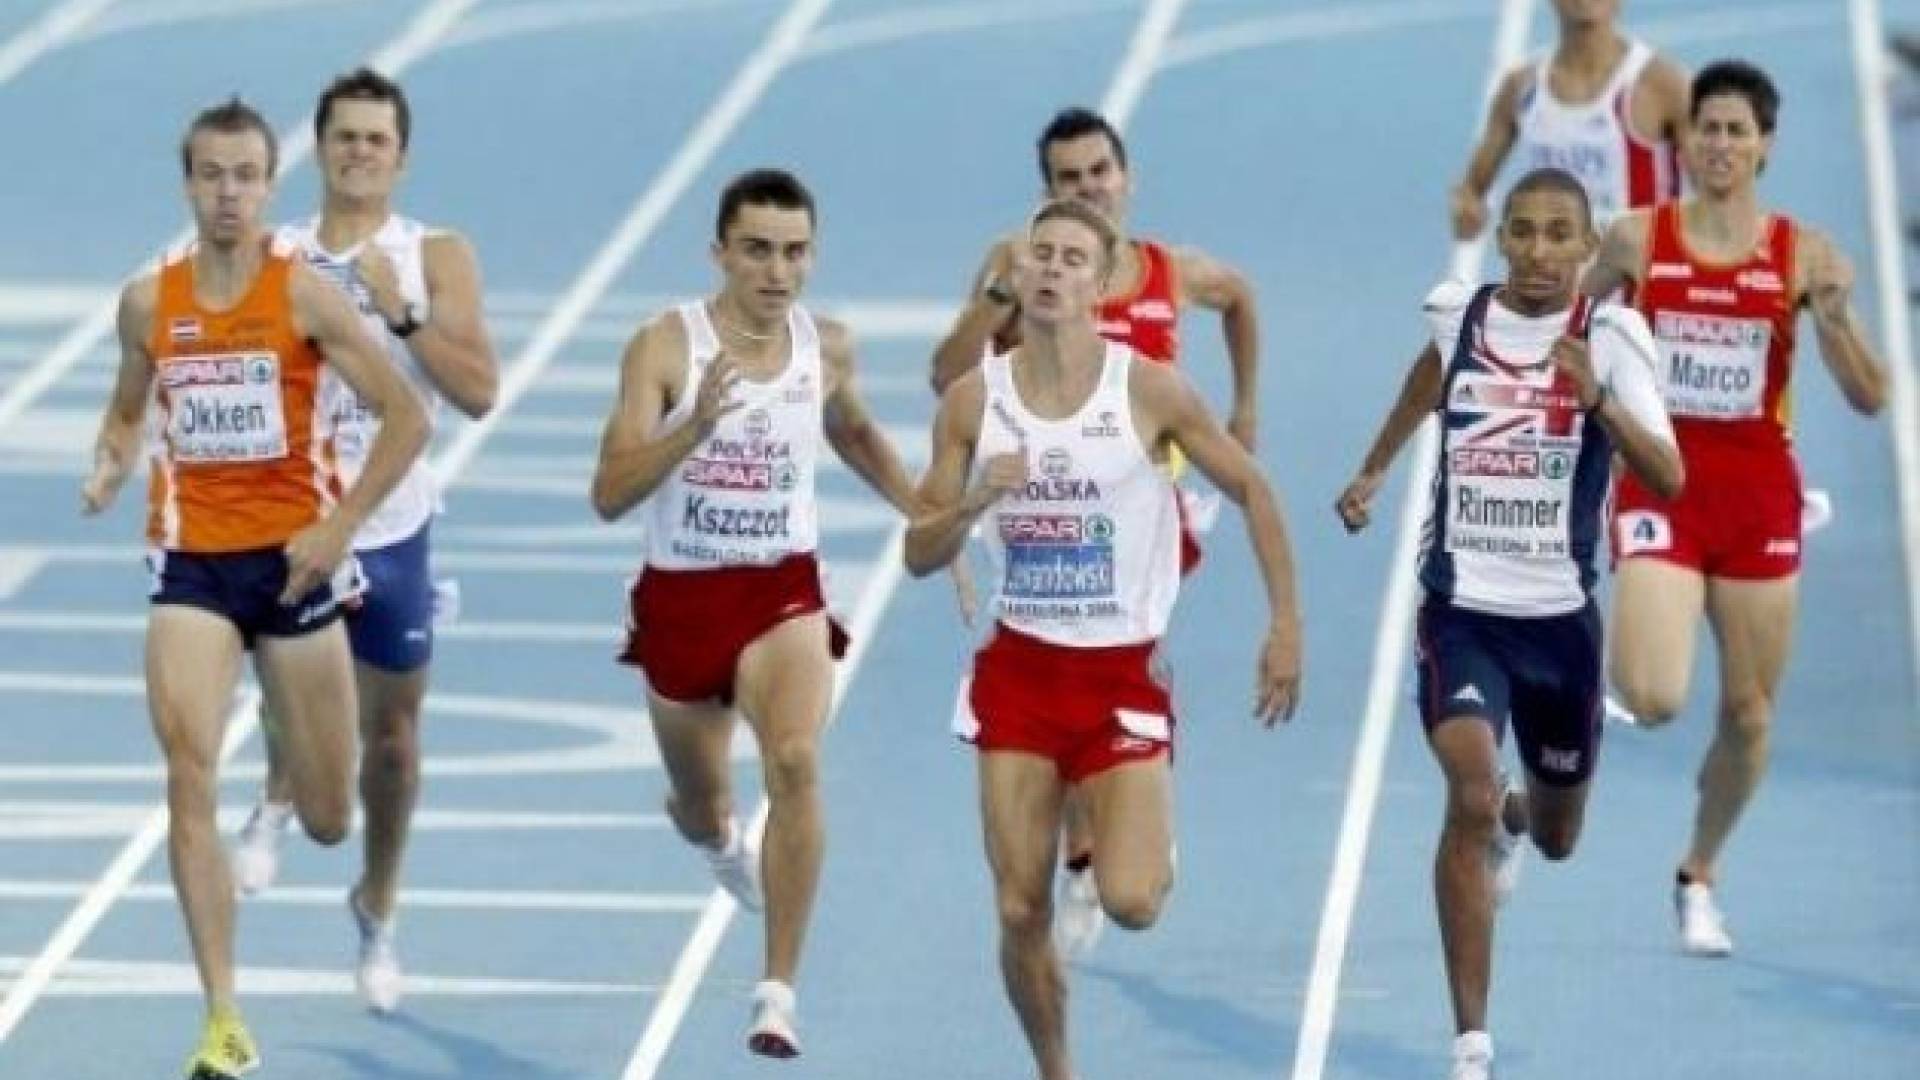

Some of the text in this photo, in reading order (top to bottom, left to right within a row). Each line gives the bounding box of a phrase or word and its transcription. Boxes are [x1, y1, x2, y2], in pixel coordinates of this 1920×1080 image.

[1656, 316, 1739, 345] SPAR
[160, 360, 243, 386] SPAR
[1671, 353, 1750, 393] Marco
[708, 439, 790, 460] POLSKA
[1453, 449, 1539, 477] SPAR
[684, 461, 770, 490] SPAR
[683, 492, 790, 538] Kszczot
[1456, 485, 1561, 528] Rimmer
[1000, 516, 1082, 541] SPAR
[1634, 517, 1656, 545] 4
